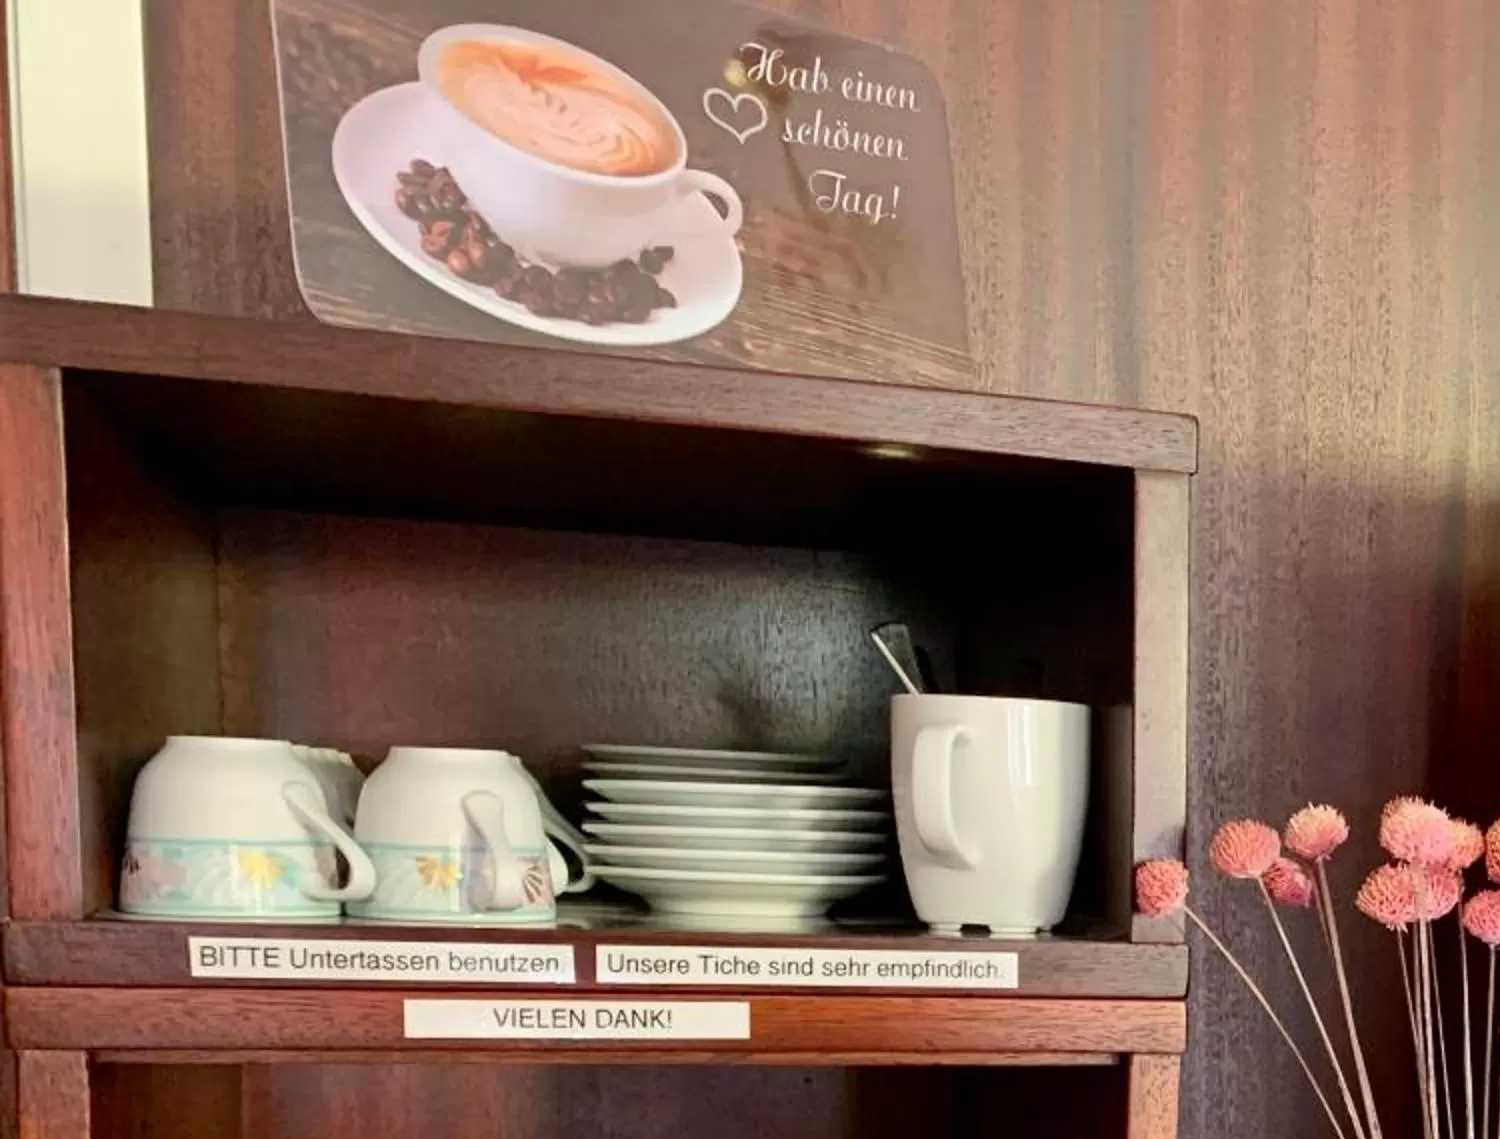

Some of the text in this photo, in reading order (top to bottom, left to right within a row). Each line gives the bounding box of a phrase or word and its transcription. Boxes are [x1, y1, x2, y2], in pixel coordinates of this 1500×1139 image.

[739, 42, 921, 112] Hab einen
[781, 108, 909, 160] schönen
[807, 168, 901, 225] Tag!
[199, 945, 560, 974] BITTE Untertassen benutzen
[606, 953, 691, 976] Unsere
[698, 953, 762, 977] Tiche
[768, 954, 815, 977] sind
[821, 955, 871, 978] sehr
[494, 1007, 673, 1030] VIELEN DANK!
